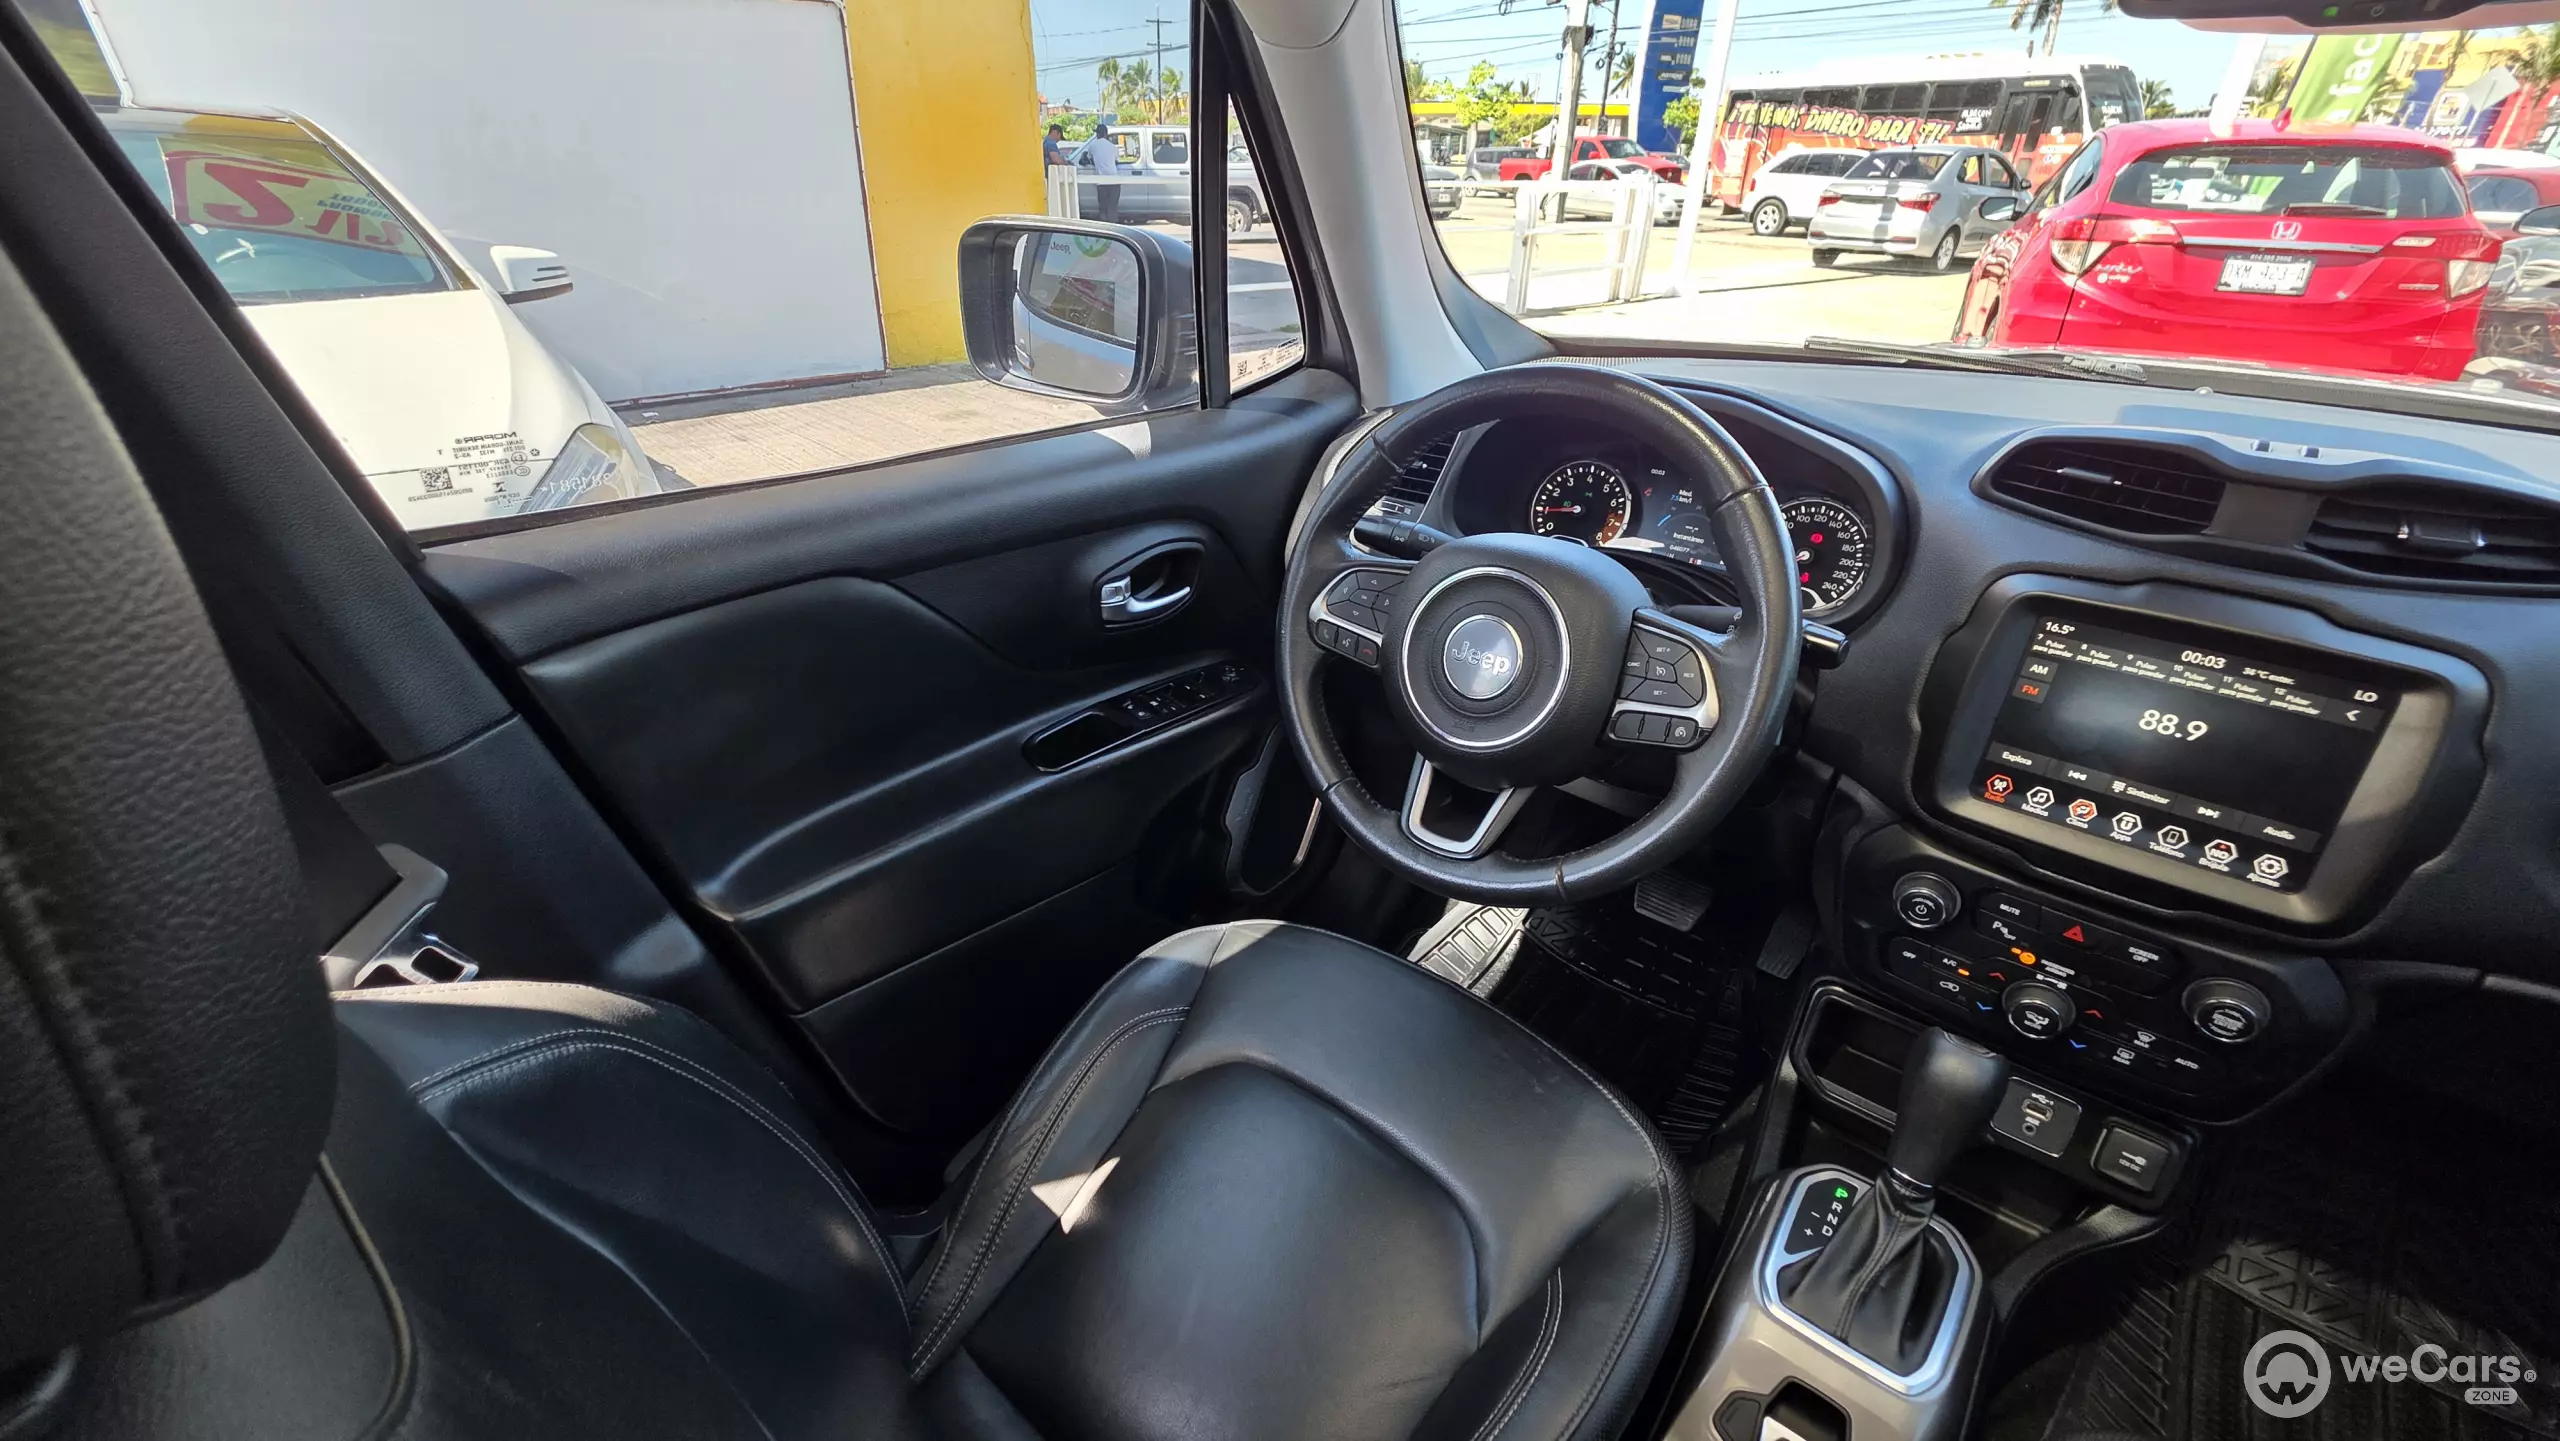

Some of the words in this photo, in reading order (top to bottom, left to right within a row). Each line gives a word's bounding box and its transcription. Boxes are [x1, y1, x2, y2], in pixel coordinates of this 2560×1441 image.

[1804, 108, 1865, 137] DINERO
[1864, 117, 1917, 144] PARA
[1567, 478, 1574, 486] 3
[1586, 475, 1593, 484] 4
[1552, 488, 1561, 497] 2
[1603, 484, 1610, 493] 5
[1610, 499, 1617, 507] 6
[1608, 519, 1615, 527] 7
[1796, 515, 1811, 523] 100
[1814, 514, 1828, 523] 120
[1546, 522, 1554, 530] 0
[1829, 520, 1843, 529] 140
[1595, 532, 1603, 540] 8
[1837, 531, 1851, 539] 160
[1841, 544, 1855, 553] 180
[1839, 558, 1855, 567] 200
[1832, 571, 1848, 579] 220
[1822, 581, 1838, 590] 240
[1452, 640, 1511, 676] Jeep
[2181, 650, 2227, 669] 00:03
[2029, 664, 2049, 675] AM
[2021, 684, 2039, 696] FM
[2353, 689, 2379, 703] LO
[2139, 708, 2208, 743] 88.9
[2002, 751, 2033, 766] Explora
[1984, 791, 2005, 803] Radio
[2125, 786, 2171, 805] Sintonizar
[2110, 830, 2132, 842] Apps
[2263, 826, 2296, 840] Audio
[2209, 848, 2229, 860] NO
[2000, 903, 2021, 916] MUTE
[1902, 950, 1916, 959] OFF
[1942, 958, 1957, 967] A/C
[2174, 1057, 2199, 1070] AUTO
[1832, 1201, 1843, 1212] R
[1827, 1213, 1838, 1225] N
[1822, 1225, 1833, 1236] D
